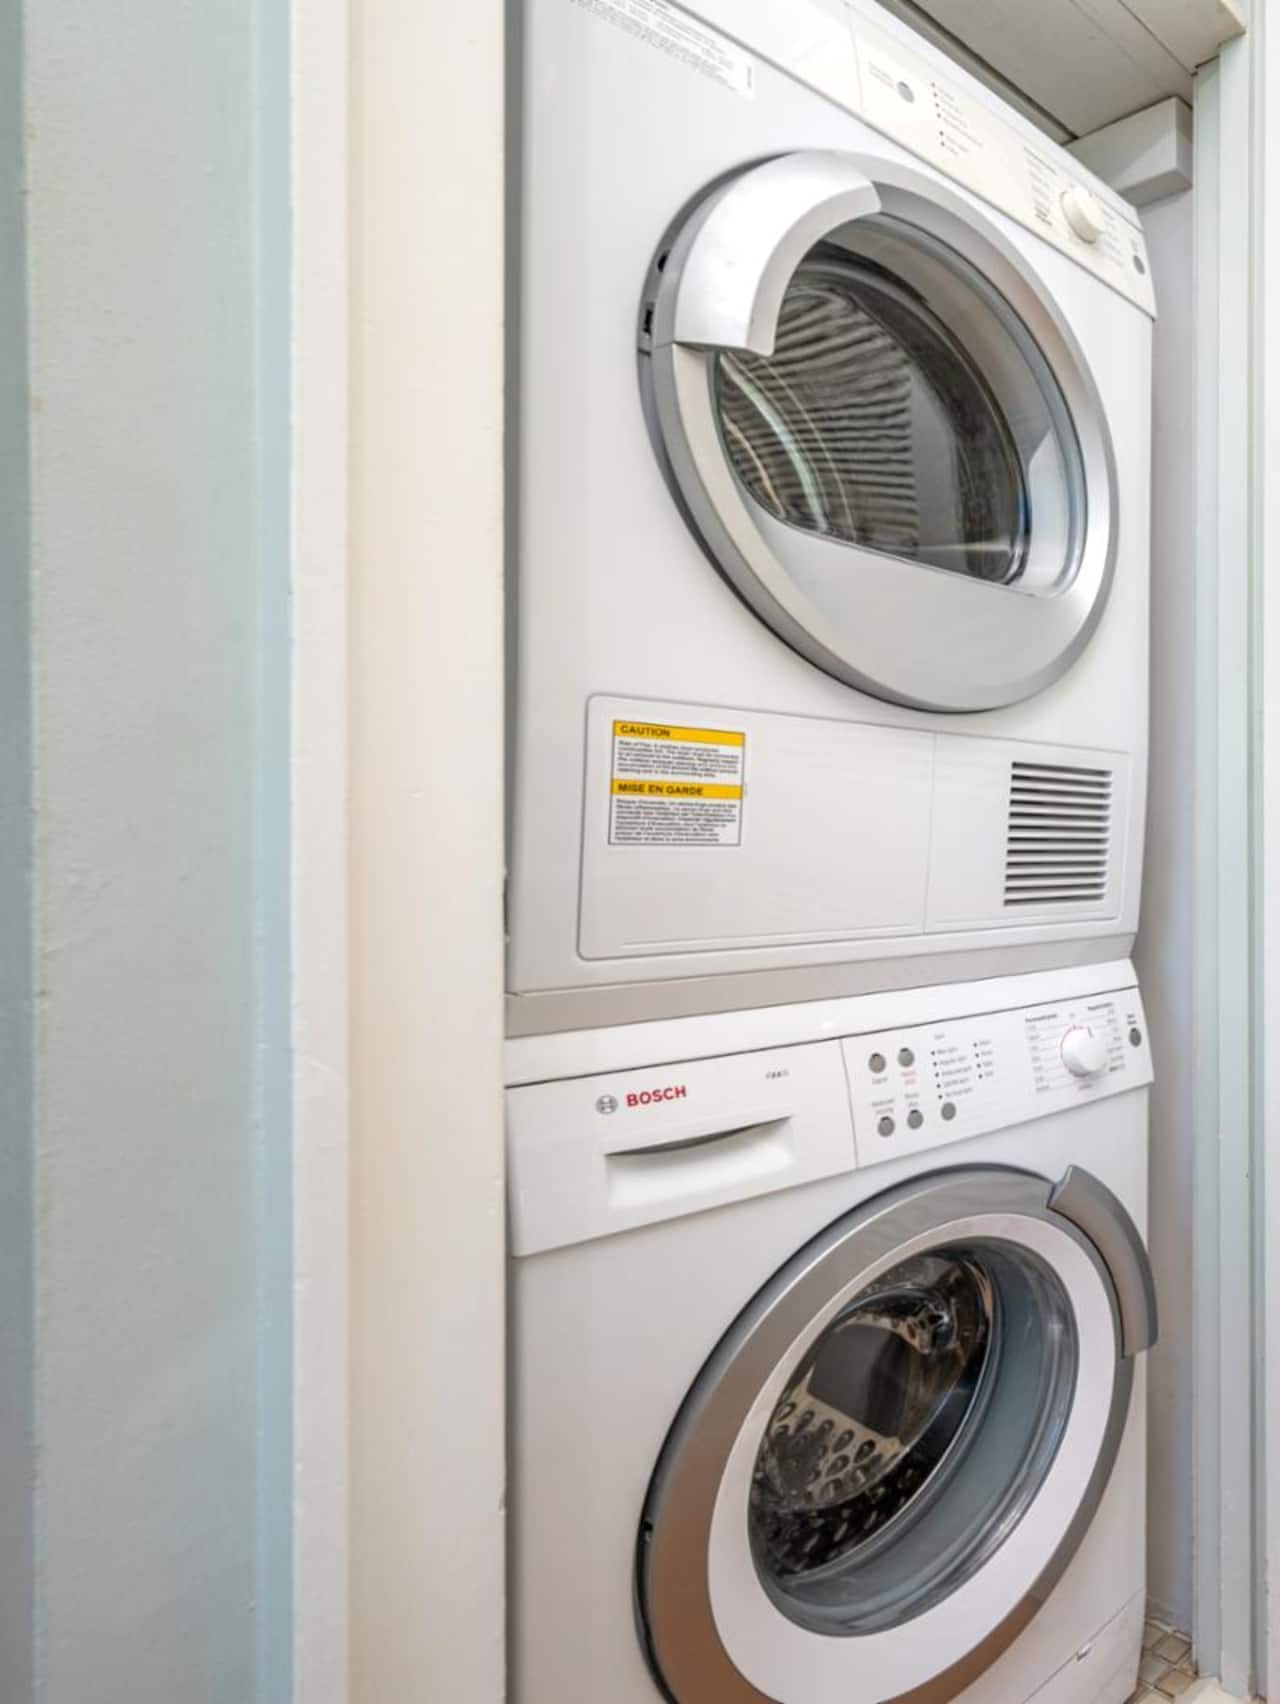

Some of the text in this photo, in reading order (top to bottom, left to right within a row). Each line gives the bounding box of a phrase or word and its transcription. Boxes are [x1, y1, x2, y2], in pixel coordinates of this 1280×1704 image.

[620, 725, 670, 737] CAUTION
[618, 783, 704, 796] MISE EN GARDE
[626, 1086, 687, 1107] BOSCH
